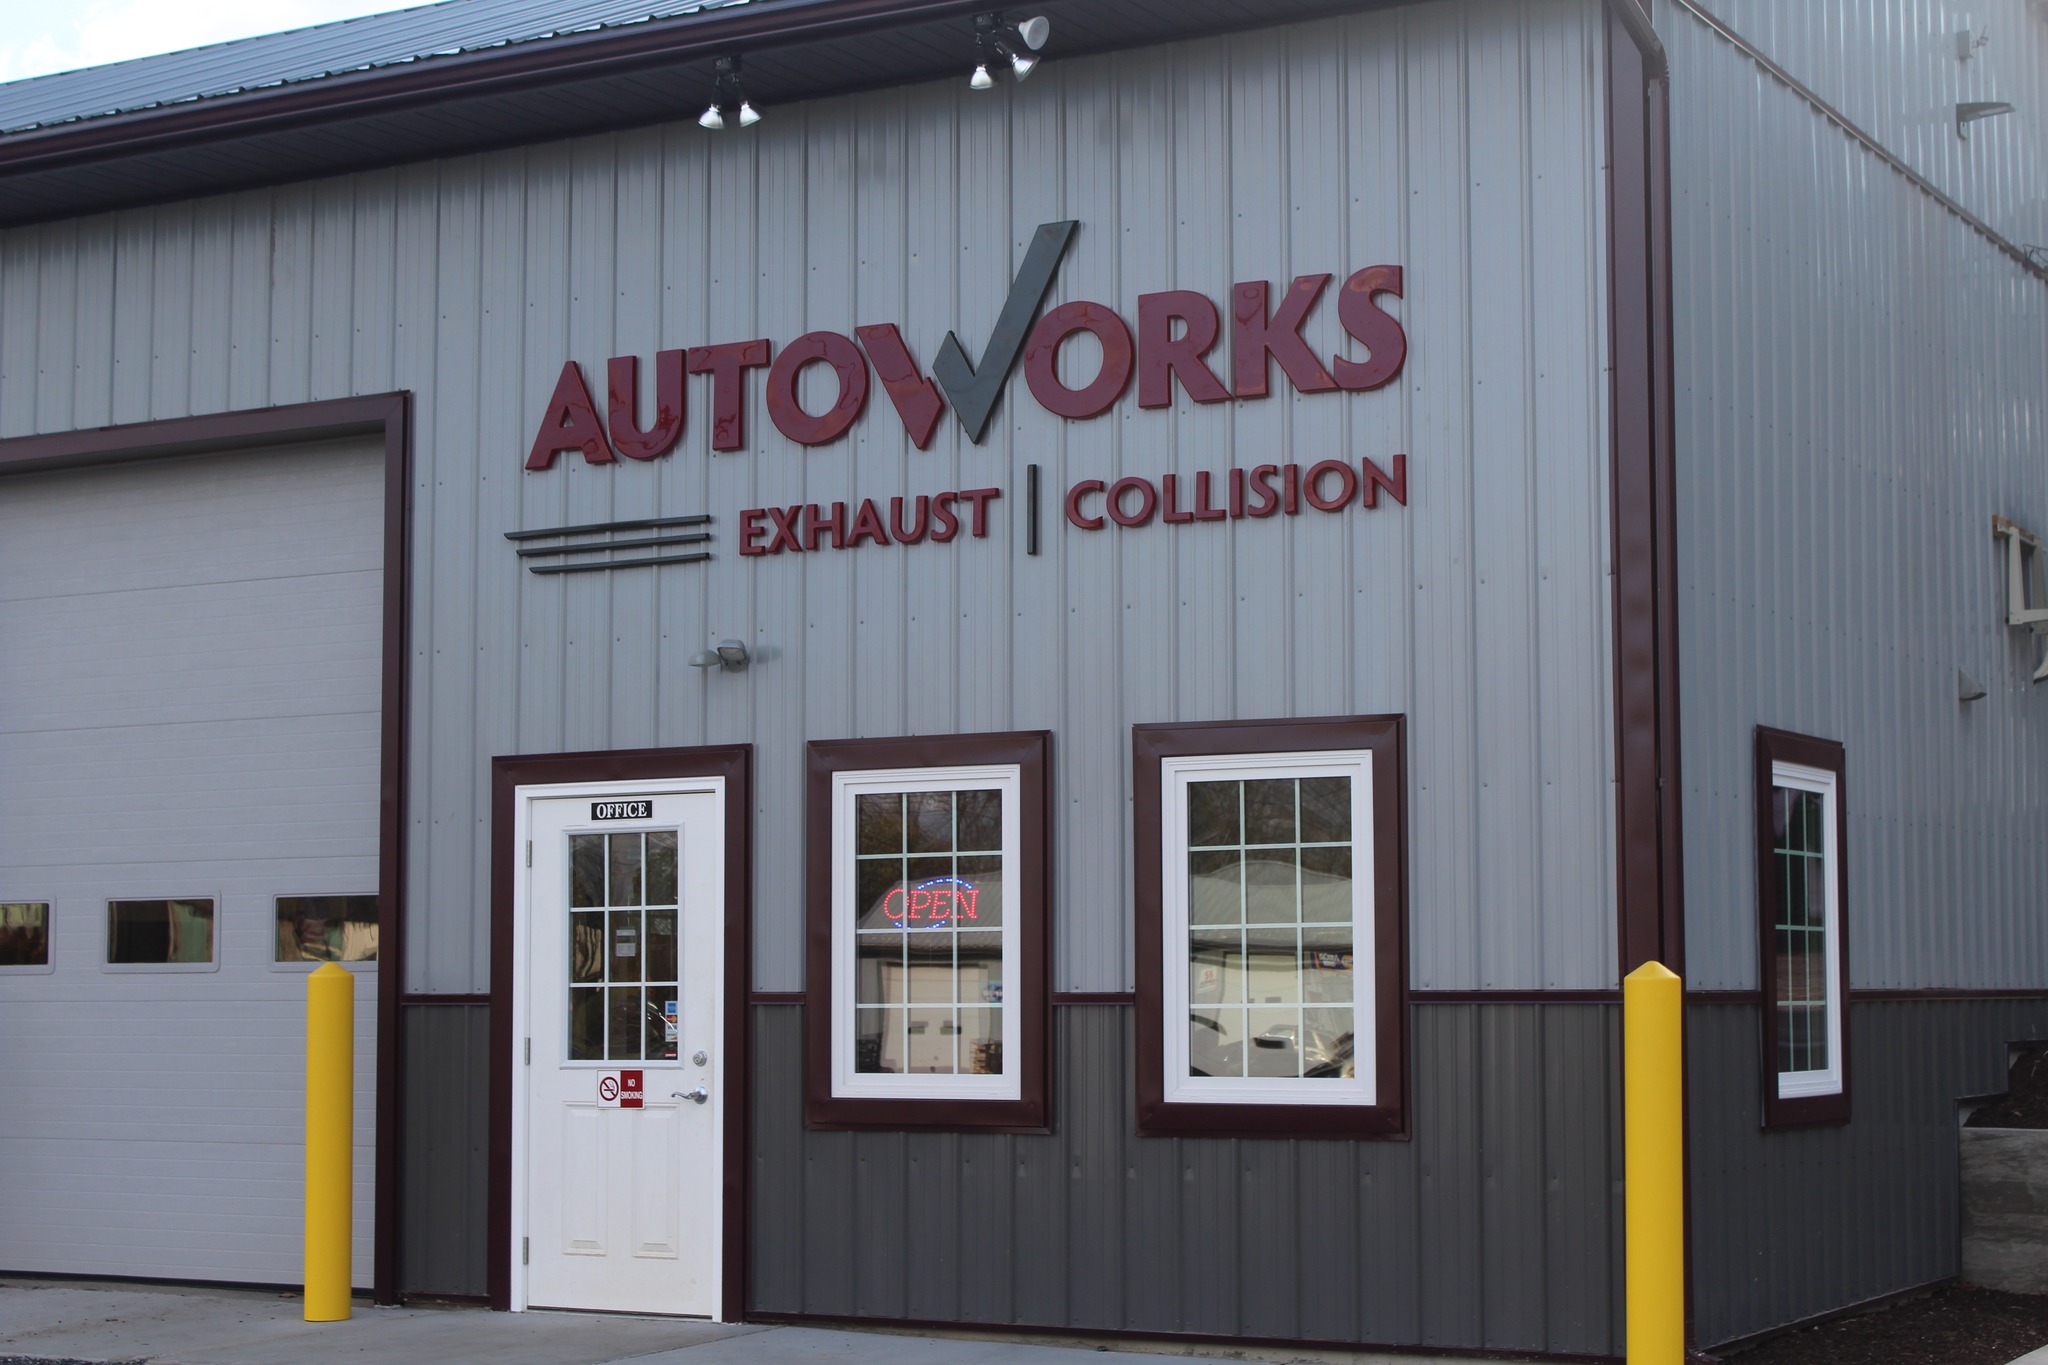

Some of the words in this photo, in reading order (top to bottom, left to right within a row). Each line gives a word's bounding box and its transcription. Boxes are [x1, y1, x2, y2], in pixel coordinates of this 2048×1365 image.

[525, 220, 1407, 470] AUTOWORKS
[739, 488, 1000, 556] EXHAUST
[1065, 454, 1407, 530] COLLISION
[596, 802, 648, 819] OFFICE
[884, 889, 979, 919] OPEN
[627, 1079, 635, 1087] NO
[620, 1091, 643, 1100] SMOKING
